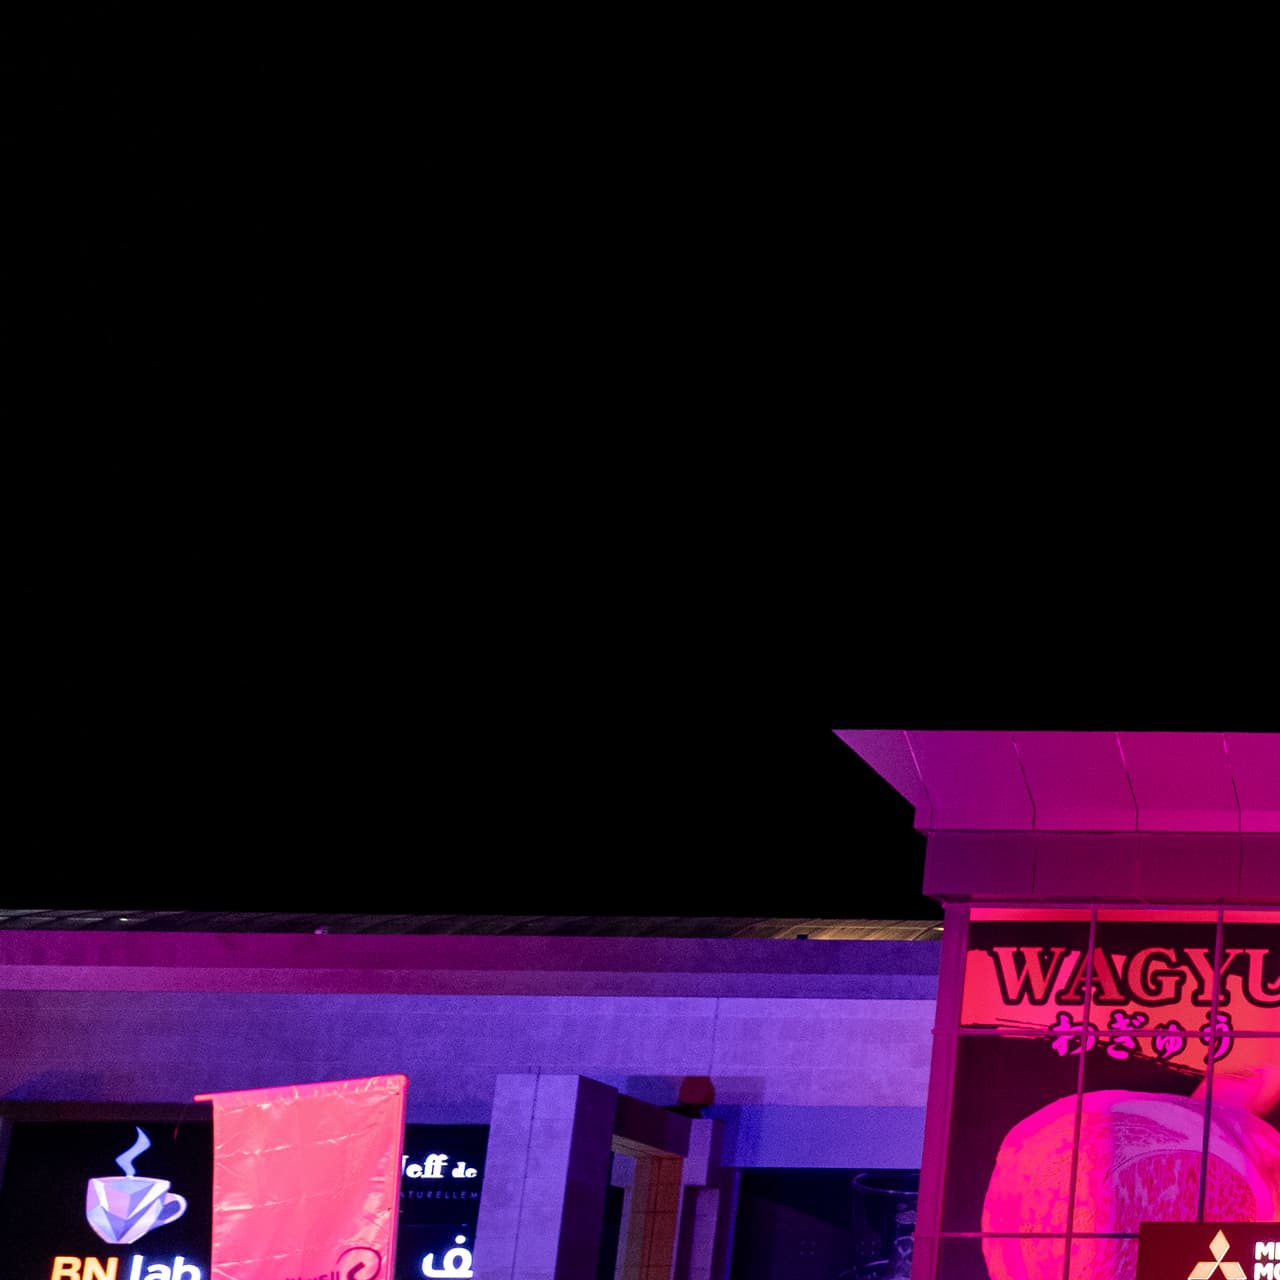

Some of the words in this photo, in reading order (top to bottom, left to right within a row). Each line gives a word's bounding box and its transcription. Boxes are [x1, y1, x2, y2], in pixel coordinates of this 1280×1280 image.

[1050, 1012, 1233, 1062] わぎゅう
[451, 1162, 478, 1178] de
